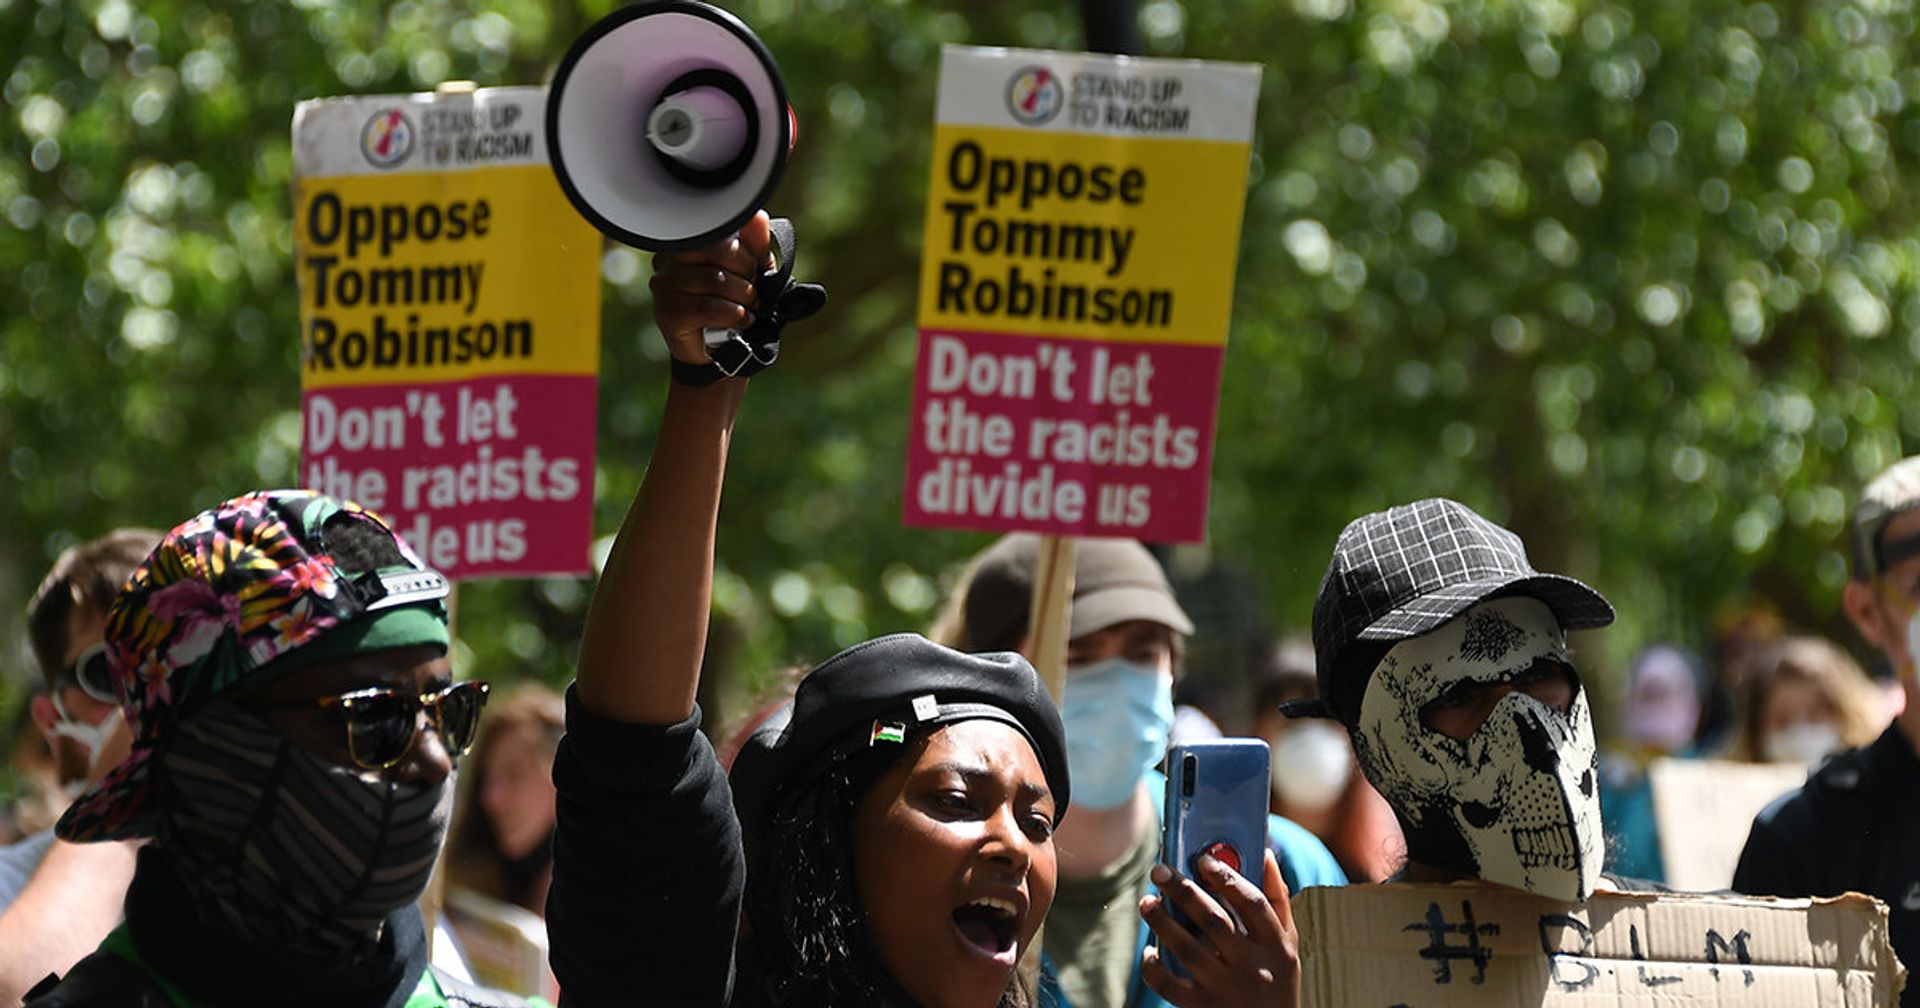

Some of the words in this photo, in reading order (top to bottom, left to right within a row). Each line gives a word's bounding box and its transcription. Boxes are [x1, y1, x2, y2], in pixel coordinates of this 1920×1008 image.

[488, 102, 523, 131] UP
[1069, 100, 1100, 127] TO
[1105, 104, 1190, 133] RACISM
[1150, 76, 1184, 104] UP
[455, 130, 534, 163] RACISM
[948, 141, 1145, 209] Oppose
[309, 193, 490, 257] Oppose
[944, 201, 1136, 277] Tommy
[306, 254, 484, 315] Tommy
[937, 261, 1174, 328] Robinson
[309, 315, 532, 371] Robinson
[928, 334, 1076, 402] Don't
[1090, 346, 1155, 407] let
[307, 389, 445, 454] Don't
[457, 384, 517, 445] let
[924, 397, 1015, 457] the
[1029, 411, 1198, 468] racists
[307, 456, 388, 510] the
[403, 447, 578, 510] racists
[918, 457, 1087, 523] divide
[1096, 481, 1153, 527] us
[465, 517, 528, 564] us
